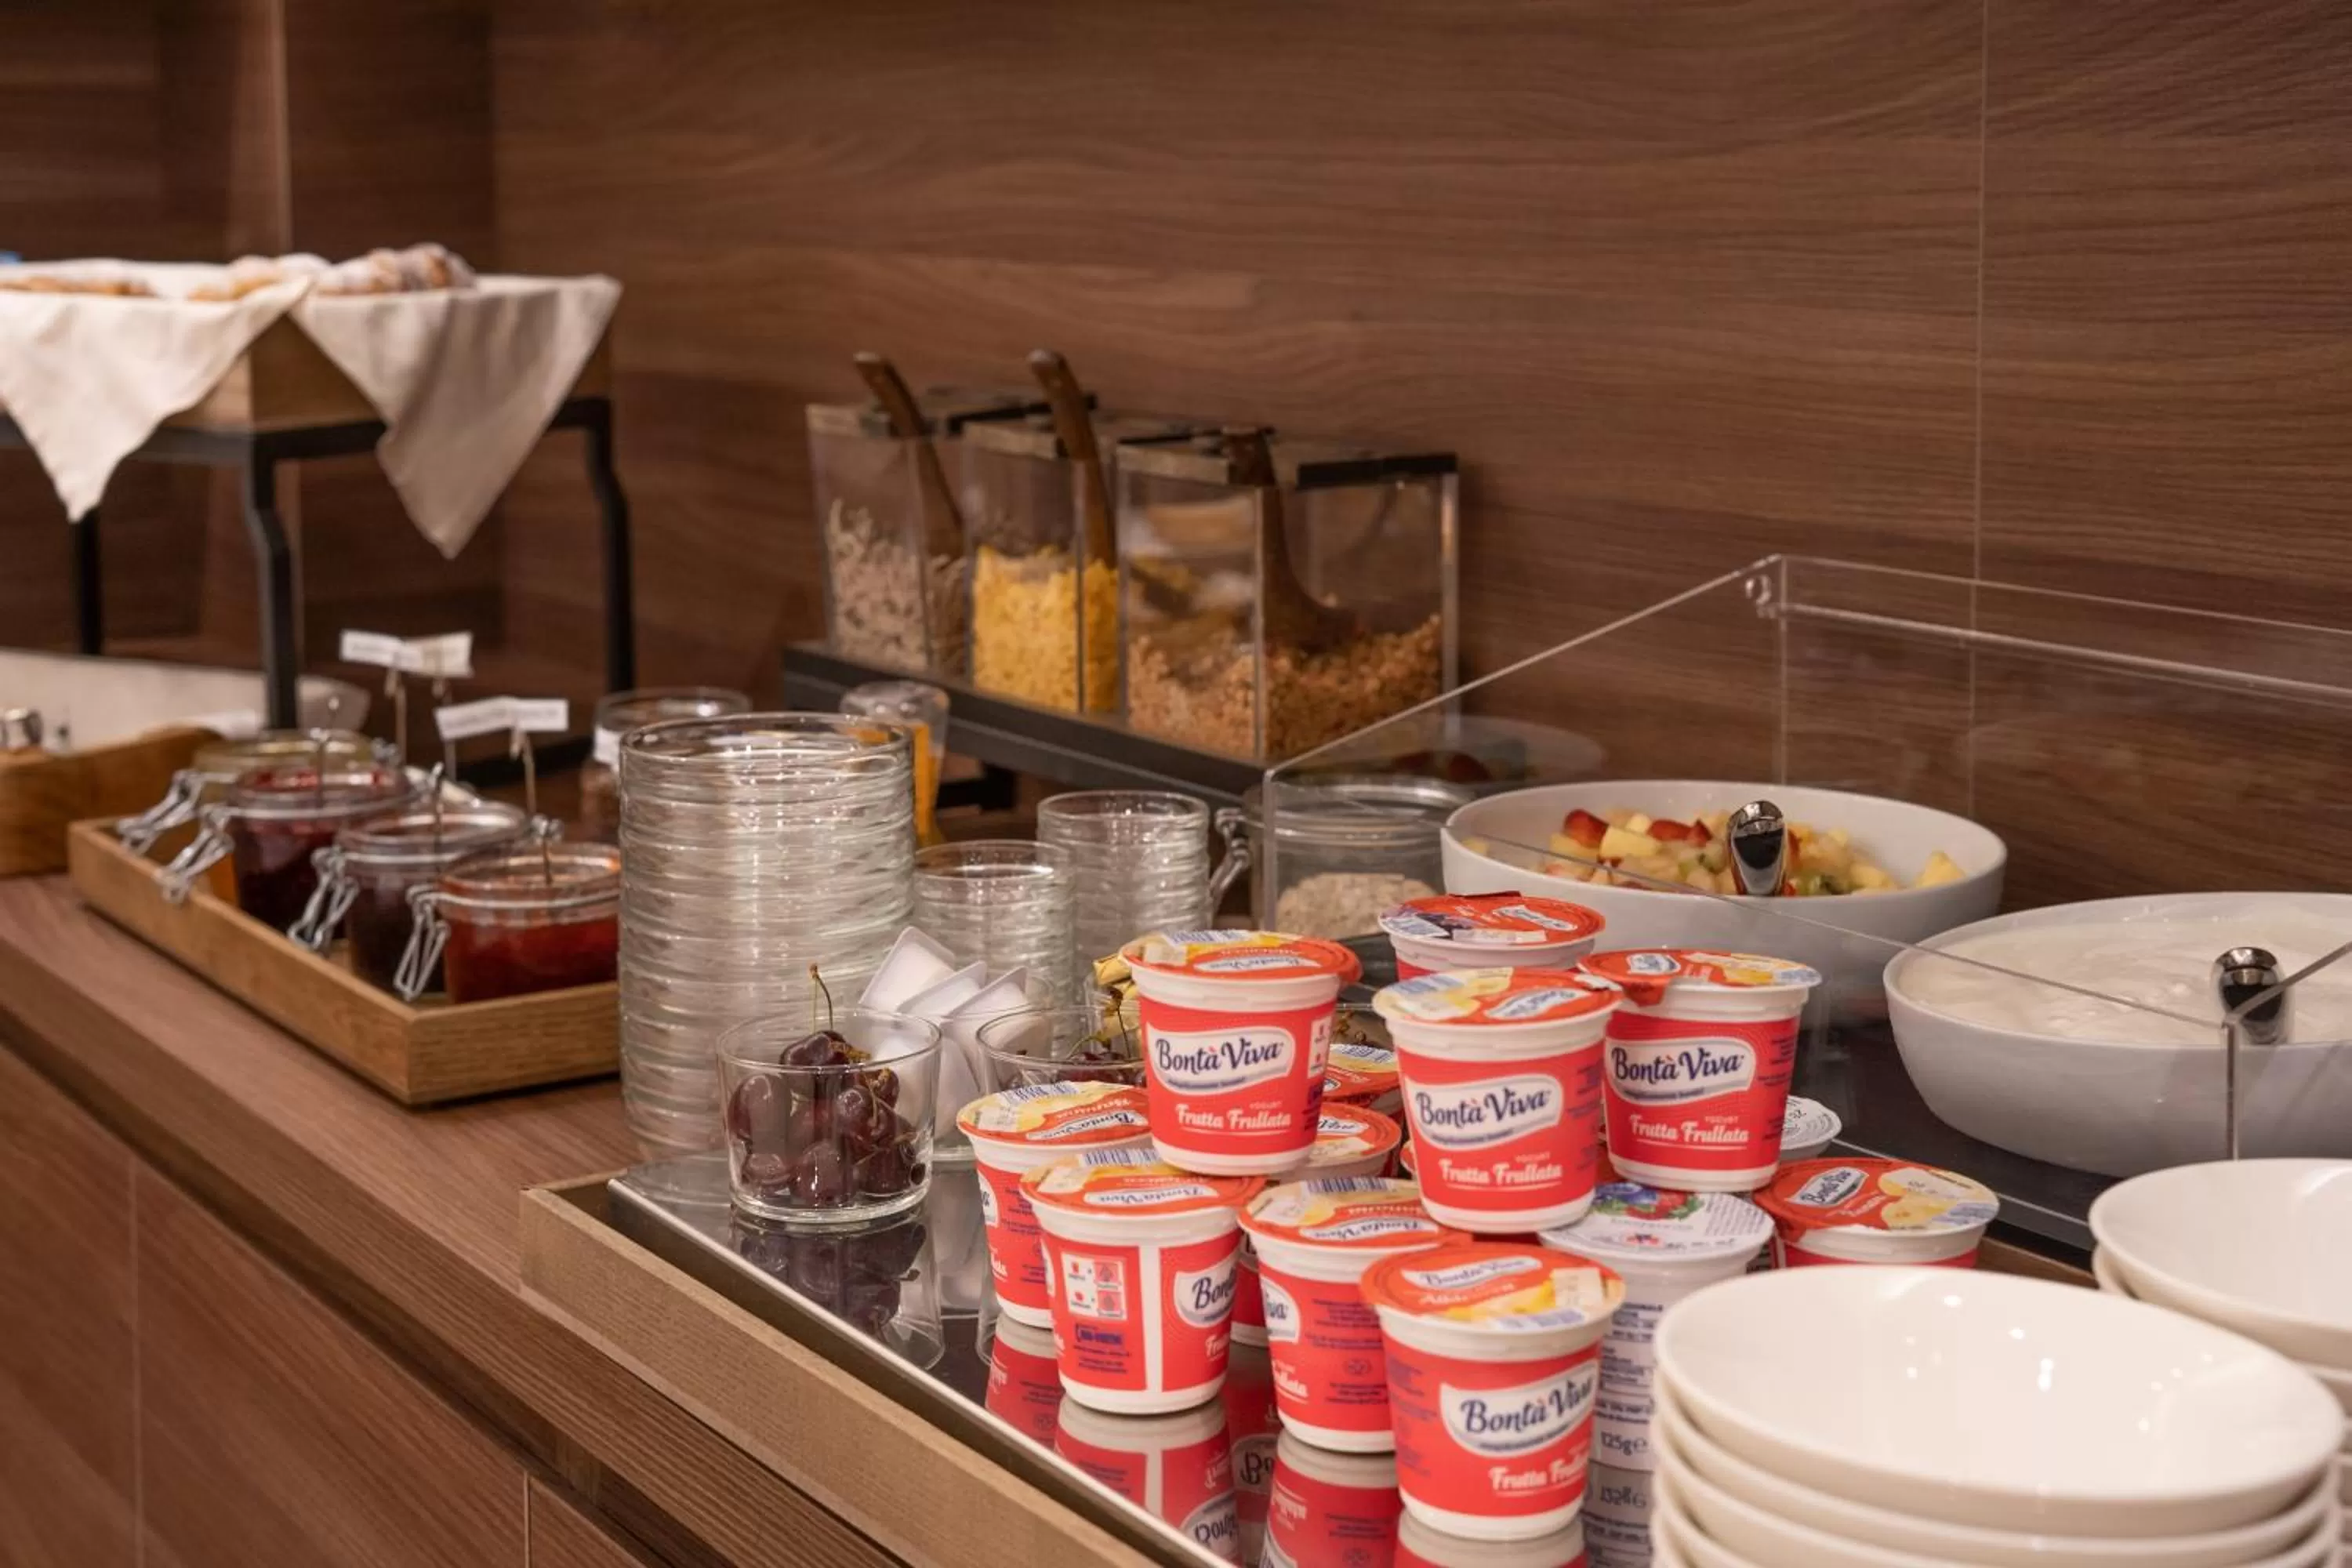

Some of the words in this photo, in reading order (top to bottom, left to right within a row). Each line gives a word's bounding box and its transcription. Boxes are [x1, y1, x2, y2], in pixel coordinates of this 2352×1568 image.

[1156, 1037, 1221, 1075] Bontà
[1220, 1036, 1281, 1069] Viva
[1612, 1047, 1679, 1084] Bontà
[1678, 1046, 1742, 1080] Viva
[1175, 1103, 1224, 1129] Frutta
[1226, 1107, 1292, 1130] Frullata
[1415, 1091, 1486, 1128] Bontà
[1484, 1087, 1550, 1121] Viva
[1629, 1114, 1679, 1141] Frutta
[1681, 1120, 1750, 1143] Frullata
[1438, 1158, 1490, 1184] Frutta
[1492, 1163, 1563, 1185] Frullata
[1460, 1399, 1548, 1434] Bontà
[1488, 1465, 1548, 1490] Frutta
